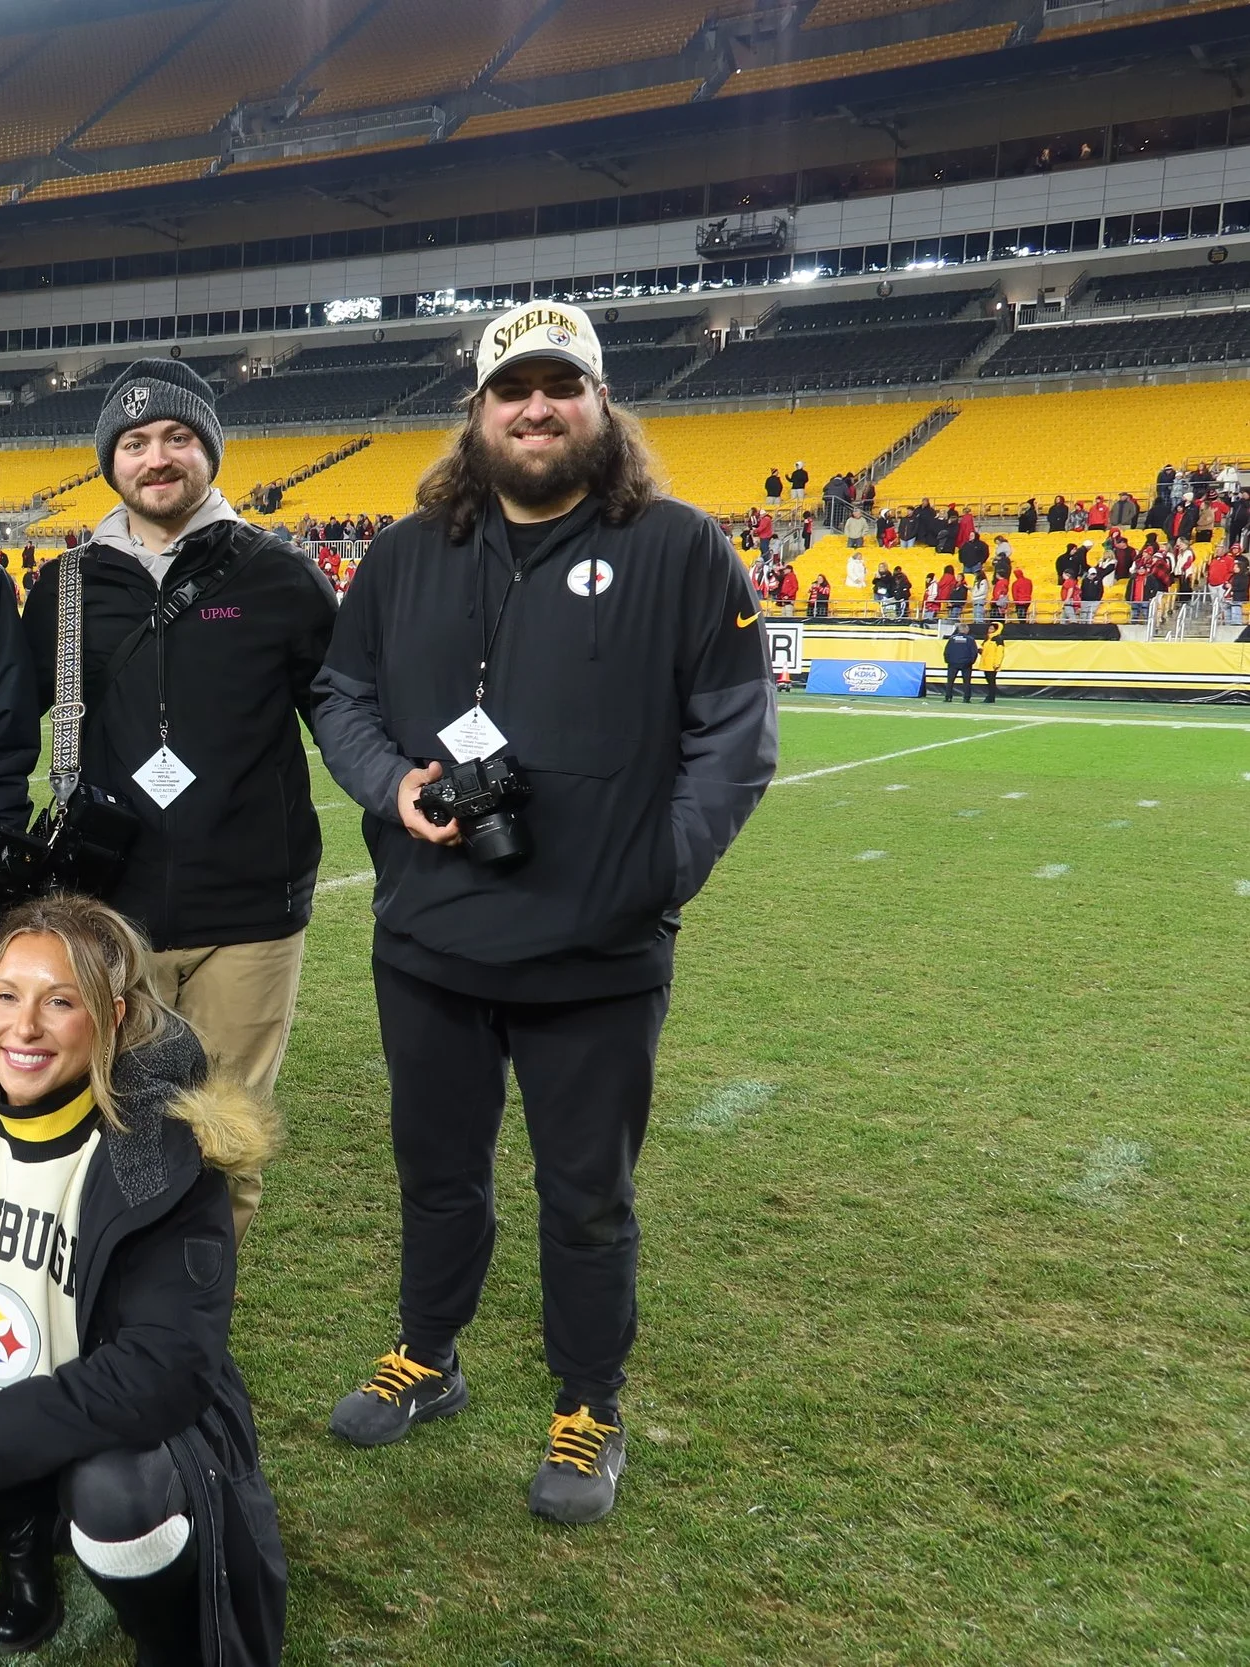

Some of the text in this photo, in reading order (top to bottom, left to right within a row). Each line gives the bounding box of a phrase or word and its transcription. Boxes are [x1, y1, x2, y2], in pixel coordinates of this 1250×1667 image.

[494, 310, 578, 362] STEELERS
[200, 606, 241, 620] UPMC
[767, 634, 793, 662] R
